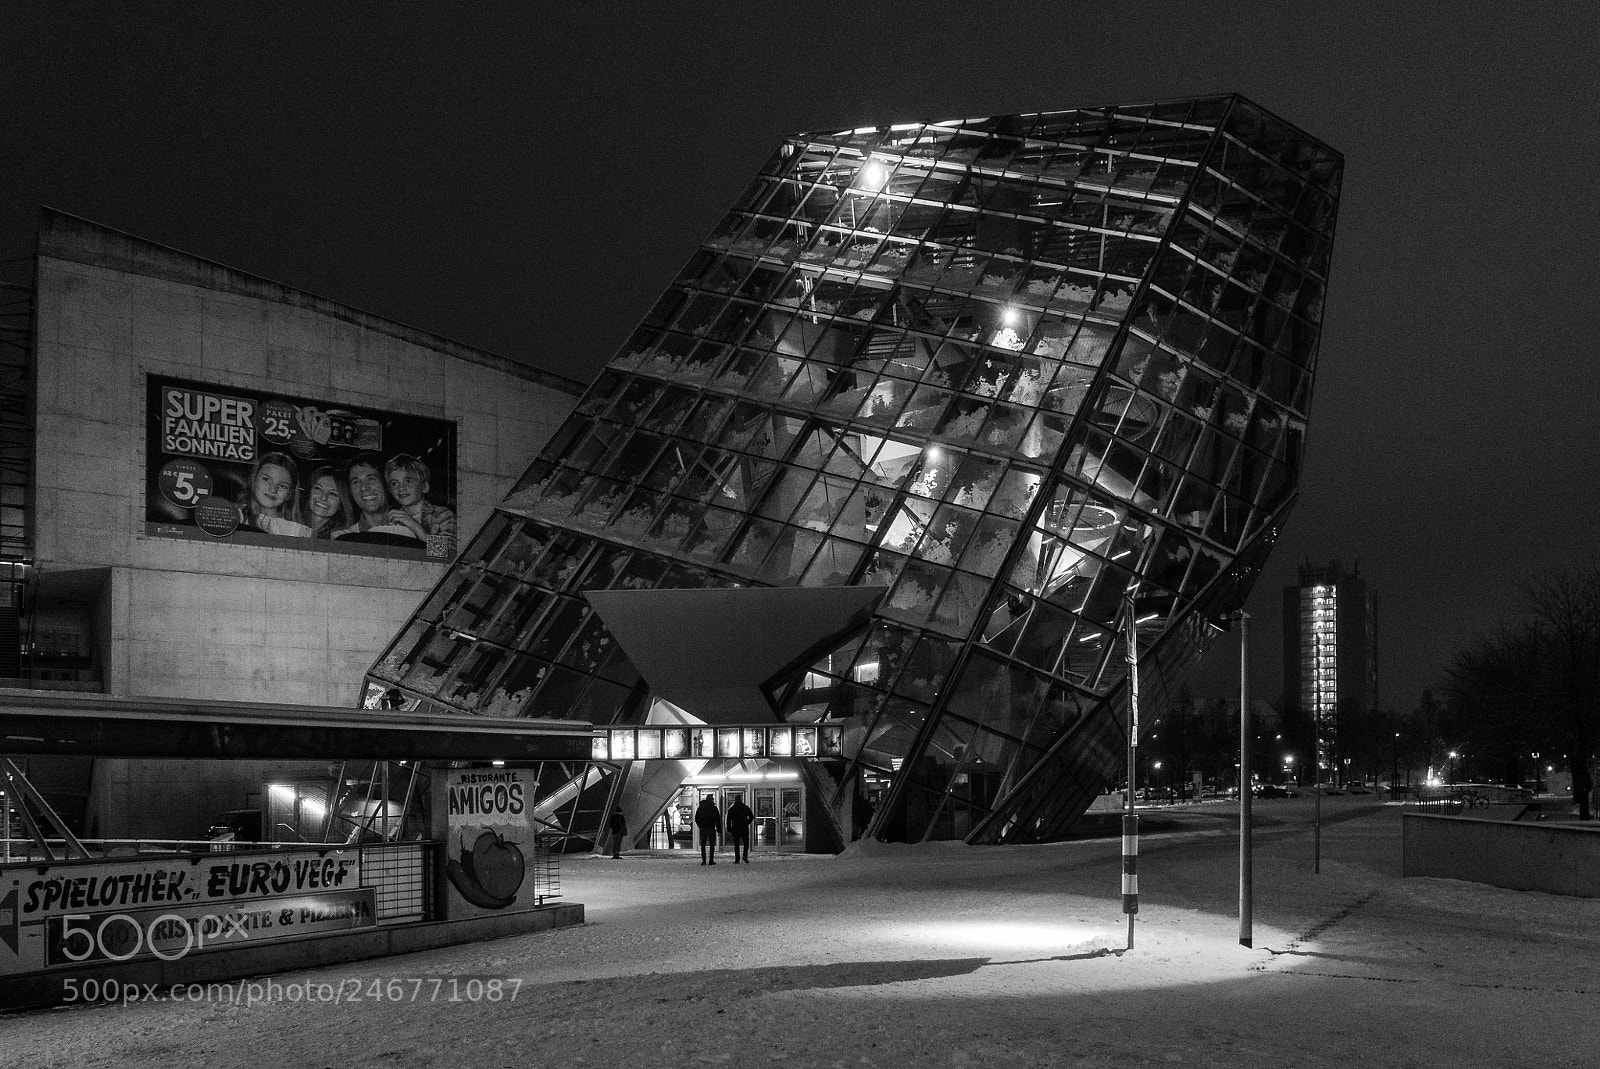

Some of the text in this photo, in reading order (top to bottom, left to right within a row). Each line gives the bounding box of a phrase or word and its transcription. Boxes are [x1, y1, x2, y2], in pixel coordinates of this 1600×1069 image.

[166, 390, 254, 428] SUPER
[266, 409, 292, 419] PAKET
[165, 416, 254, 445] FAMILIEN
[166, 434, 254, 460] SONNTAG
[449, 783, 524, 815] AMIGOS
[279, 908, 295, 926] &
